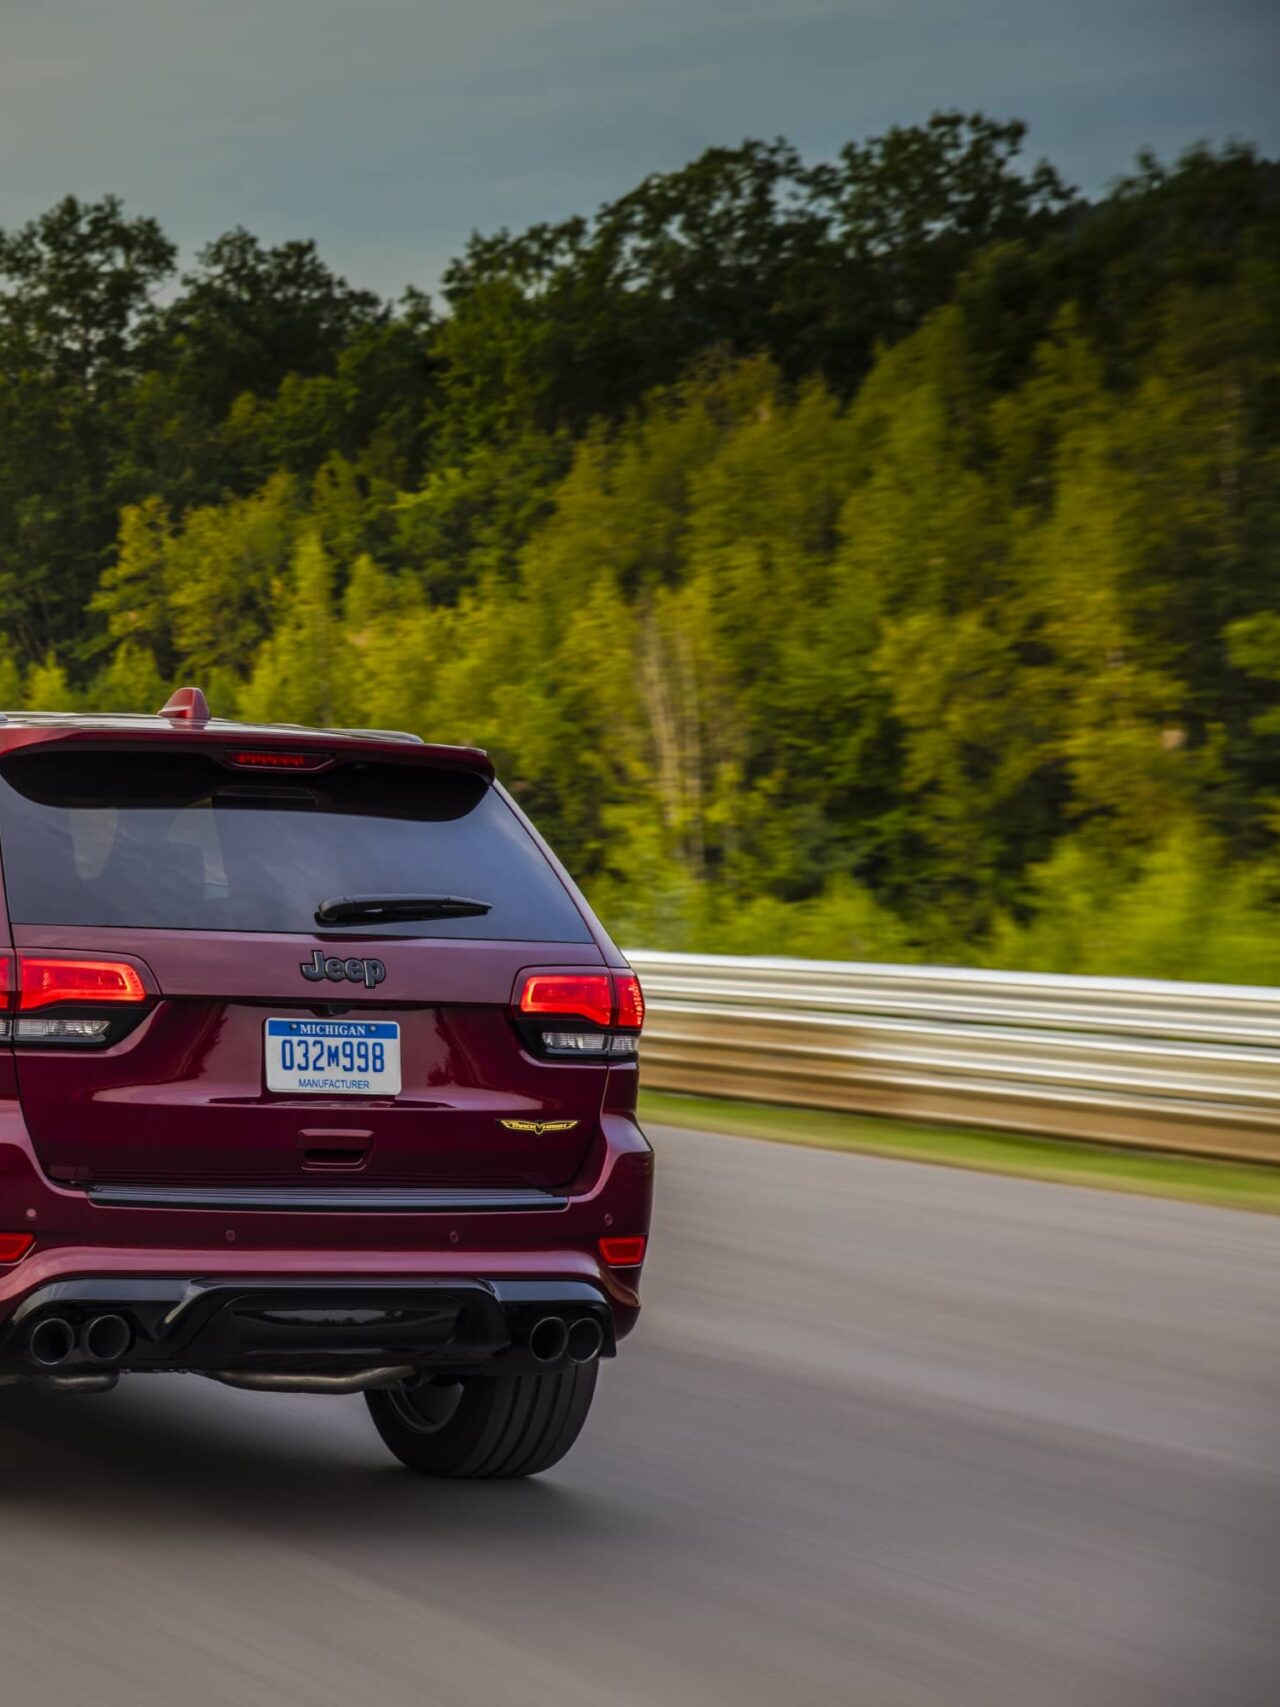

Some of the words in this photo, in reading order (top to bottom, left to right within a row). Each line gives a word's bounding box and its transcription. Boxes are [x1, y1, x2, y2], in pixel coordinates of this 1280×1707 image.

[300, 950, 386, 988] Jeep
[300, 1024, 365, 1036] MICHIGAN
[281, 1039, 385, 1073] 032M998
[298, 1078, 370, 1089] MANUFACTURER
